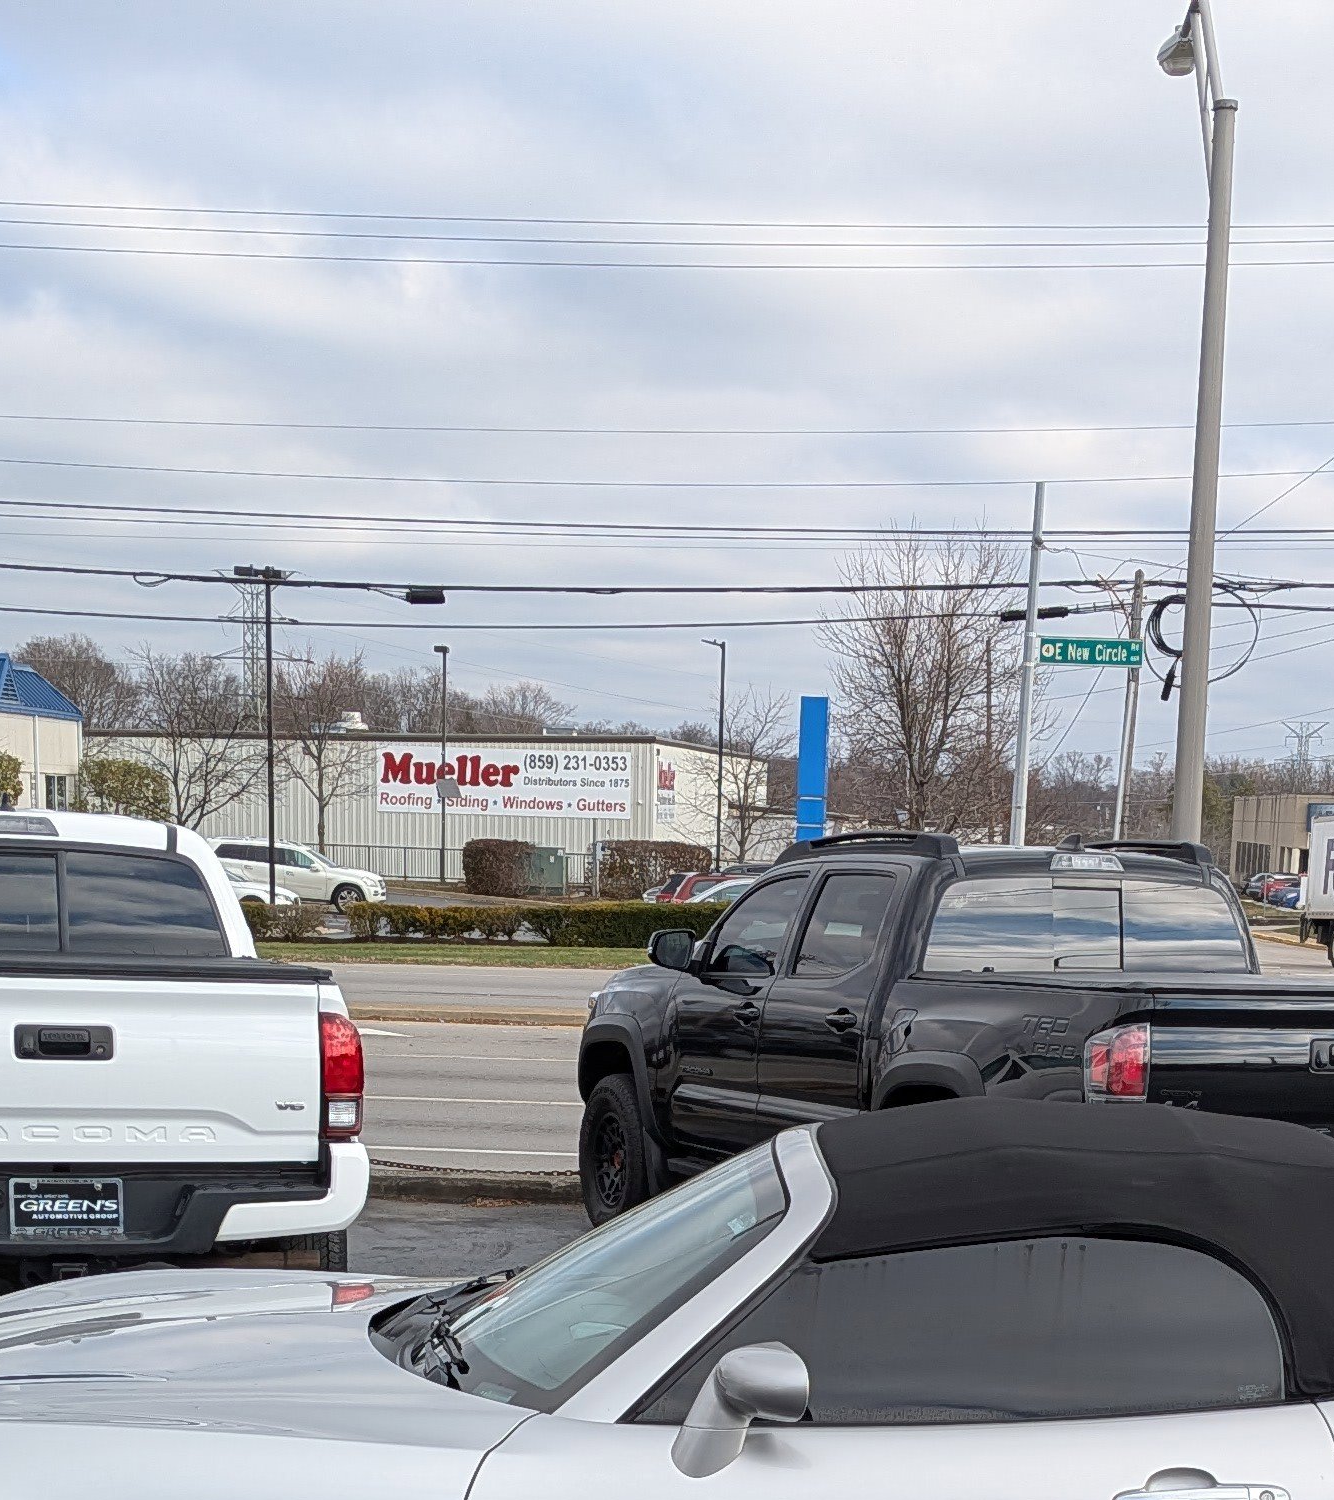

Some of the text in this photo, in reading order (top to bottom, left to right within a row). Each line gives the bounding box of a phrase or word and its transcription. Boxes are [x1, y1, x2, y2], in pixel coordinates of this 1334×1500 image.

[1055, 642, 1064, 660] E
[1067, 643, 1091, 660] New
[1095, 644, 1128, 662] Circle
[380, 752, 520, 788] Mueller
[523, 753, 628, 774] (859) 231-0353
[523, 776, 630, 788] Distributors Since 1875
[379, 792, 626, 813] Roofing Siding Windows Gutters
[1022, 1014, 1070, 1039] TRD
[19, 1199, 118, 1212] GREEN'S
